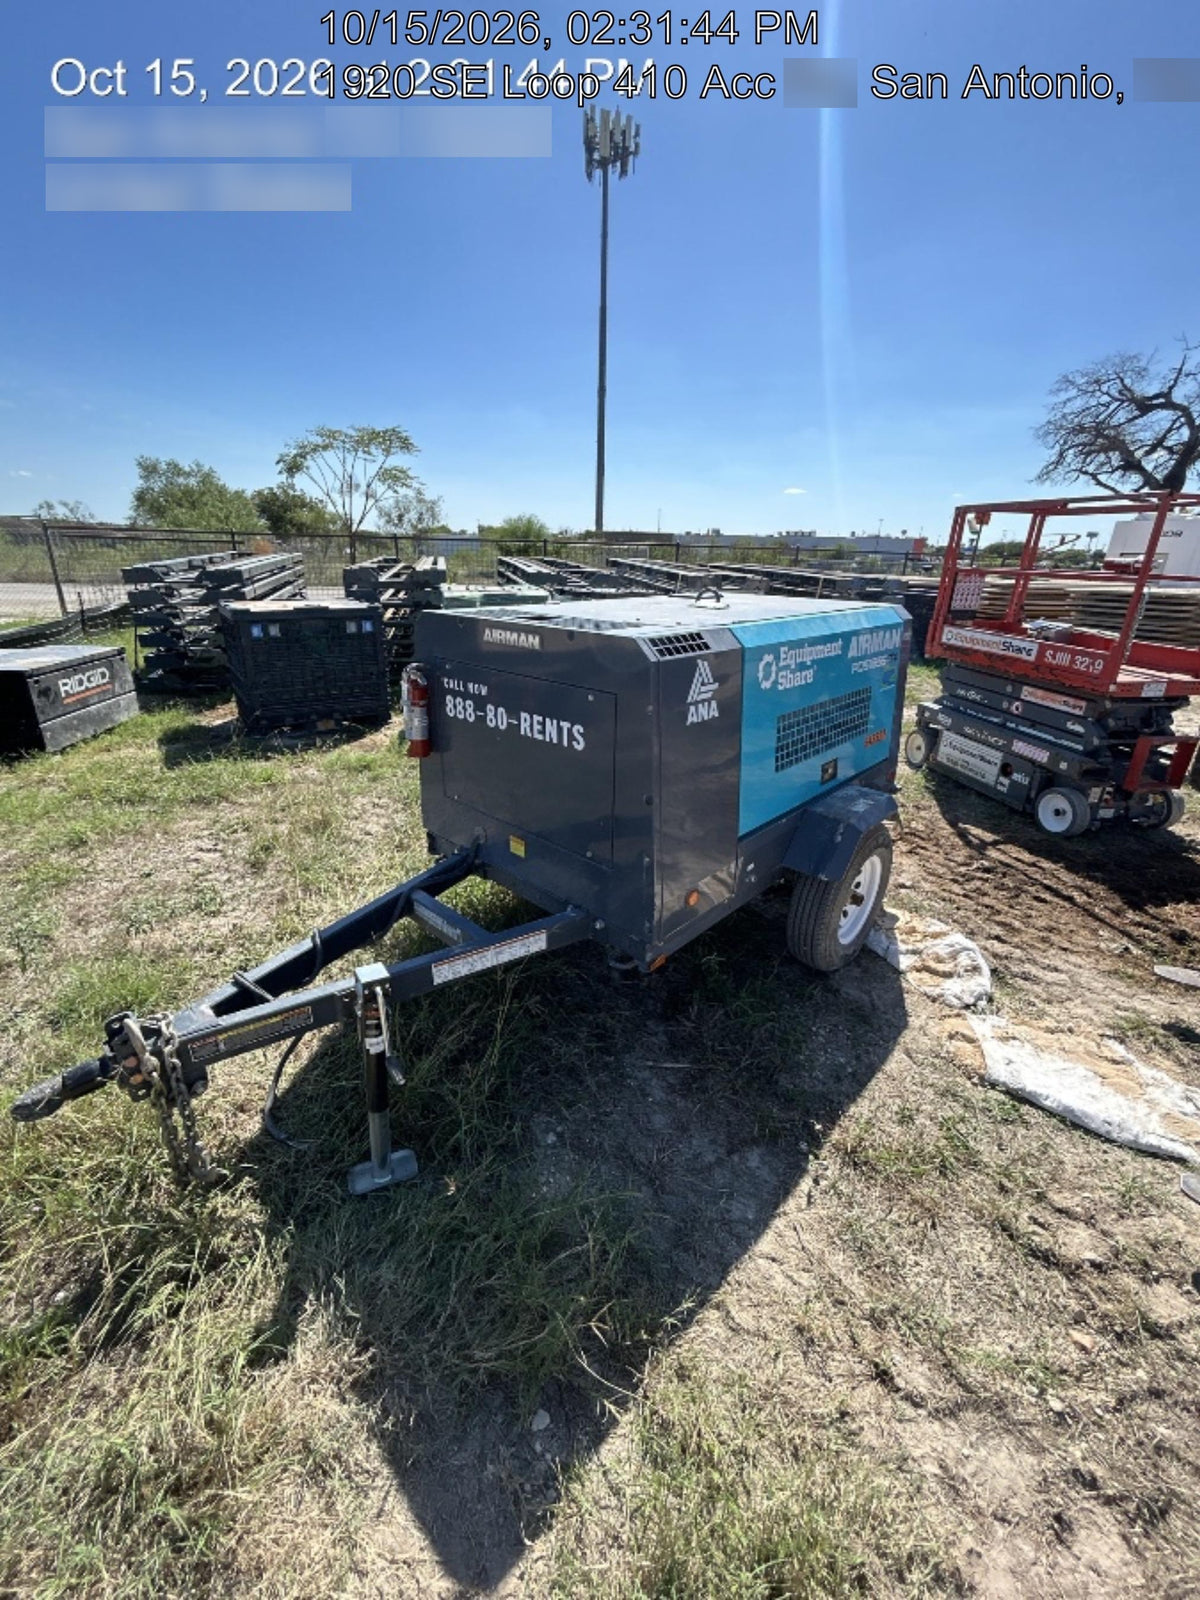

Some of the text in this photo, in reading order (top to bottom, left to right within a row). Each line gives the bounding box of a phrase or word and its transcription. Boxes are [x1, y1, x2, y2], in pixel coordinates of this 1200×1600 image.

[483, 627, 541, 650] AIRMAN
[848, 630, 900, 658] AIRMAN
[779, 639, 843, 668] Equipment
[59, 668, 110, 697] RIDGID
[443, 676, 465, 693] CALL
[777, 669, 814, 690] Share
[445, 695, 586, 751] 888-80-RENTS
[686, 700, 719, 726] ANA
